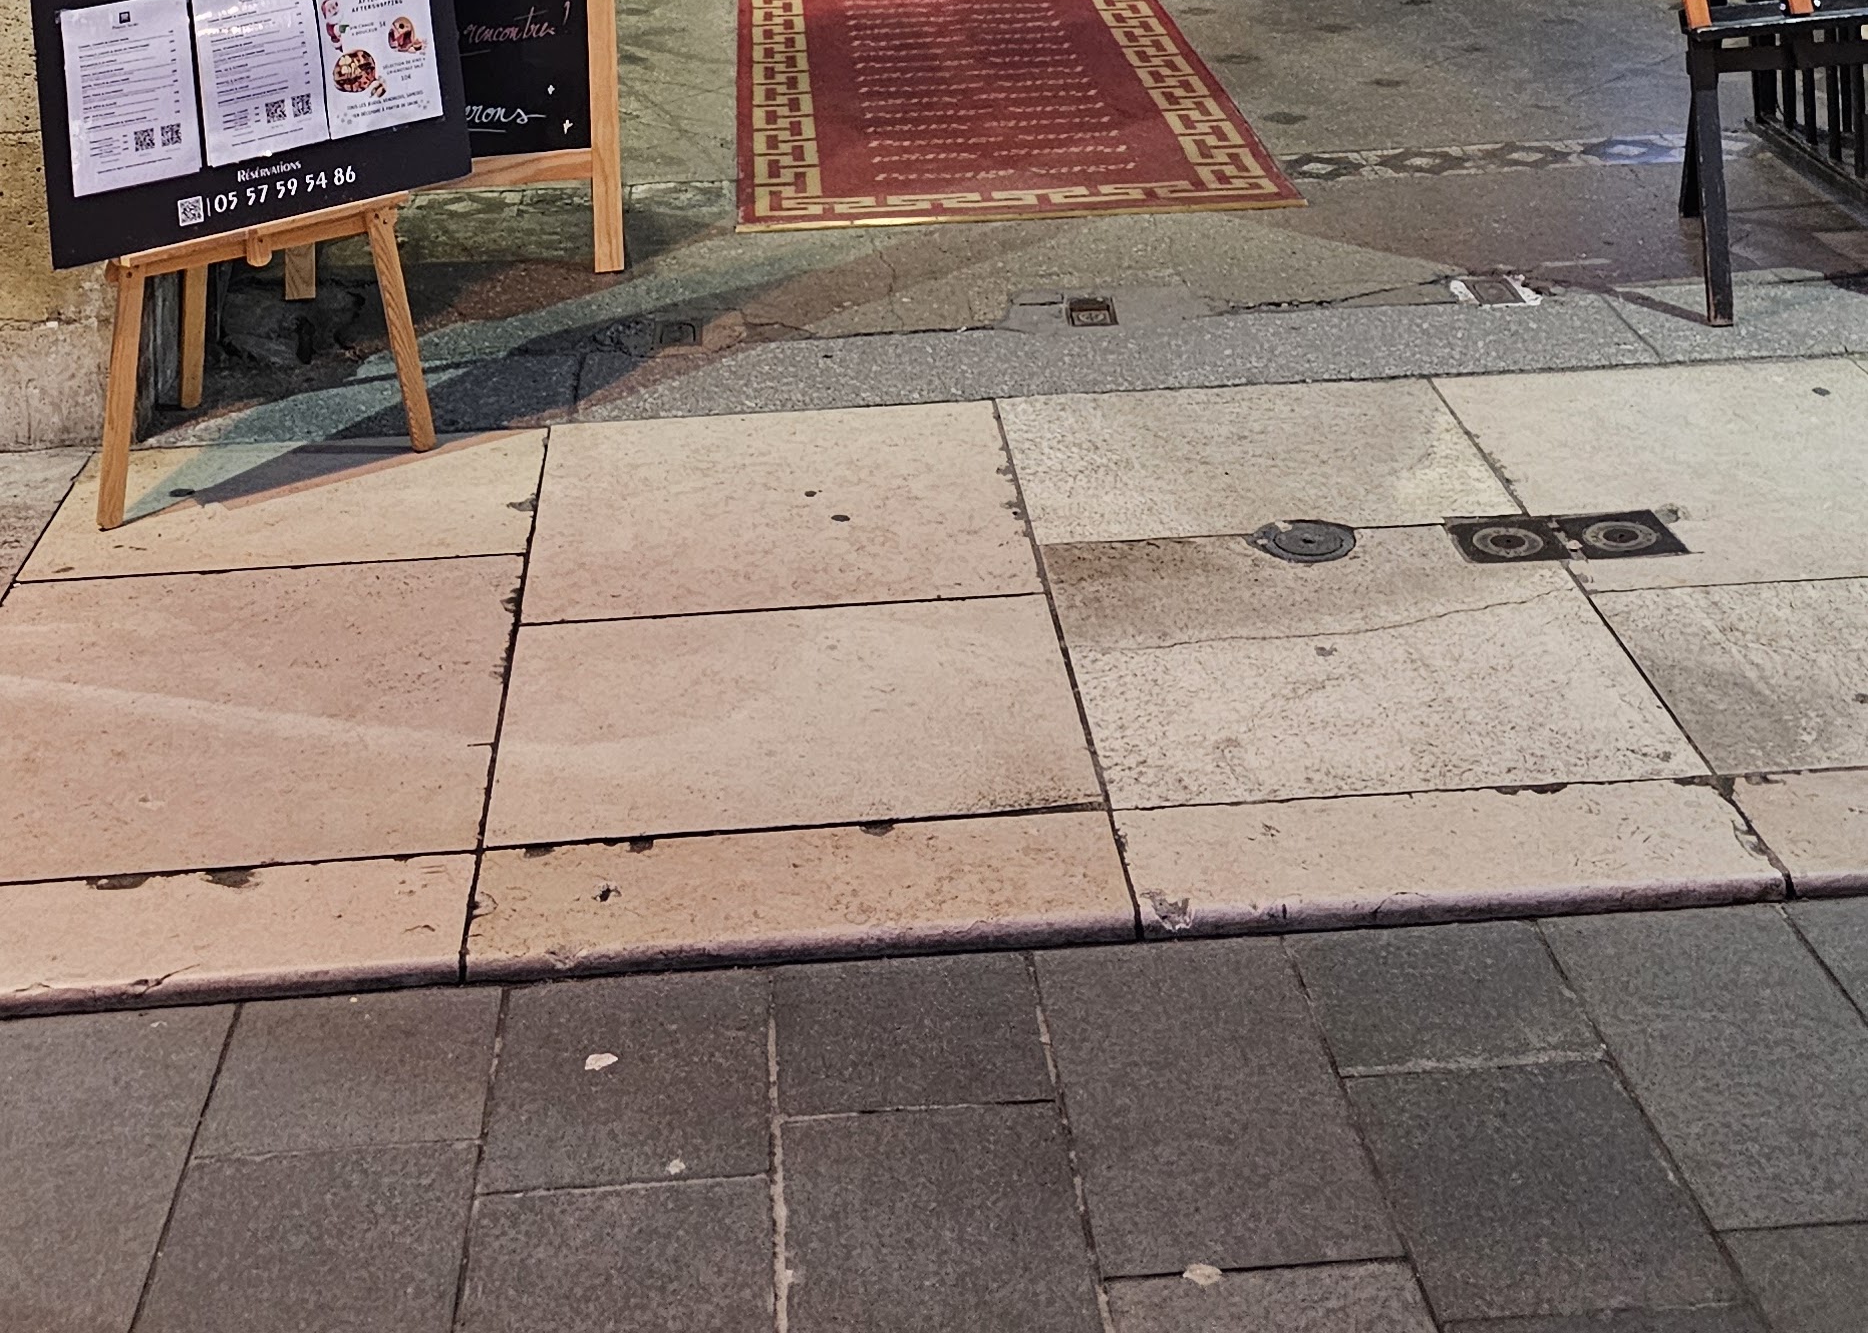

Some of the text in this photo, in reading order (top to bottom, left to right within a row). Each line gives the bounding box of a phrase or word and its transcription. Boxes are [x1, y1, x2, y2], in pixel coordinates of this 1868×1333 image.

[213, 164, 356, 213] 05 57 59 54 86
